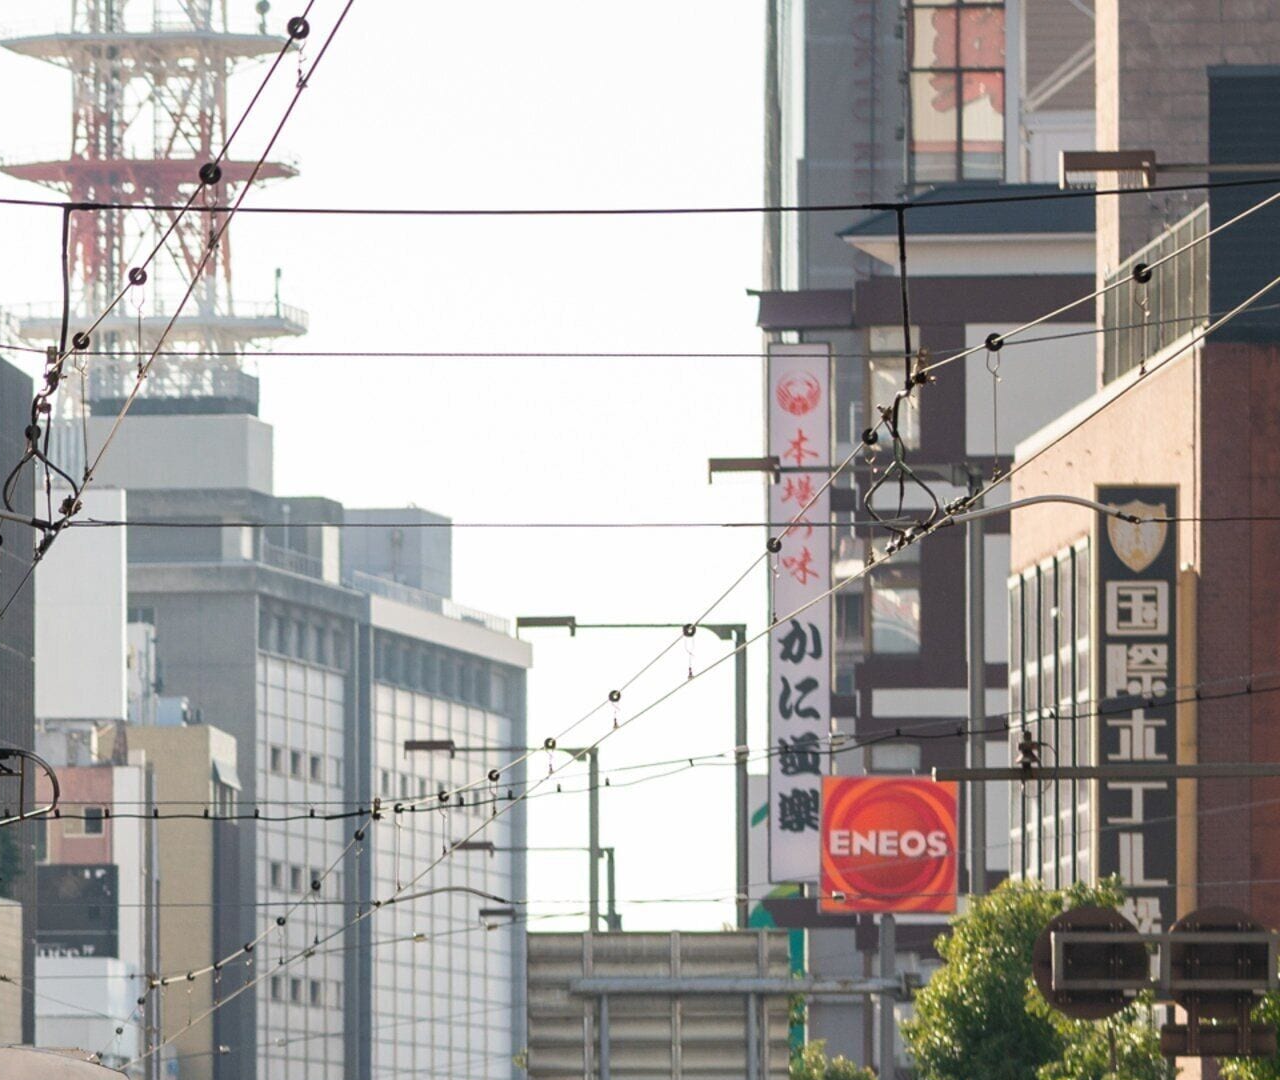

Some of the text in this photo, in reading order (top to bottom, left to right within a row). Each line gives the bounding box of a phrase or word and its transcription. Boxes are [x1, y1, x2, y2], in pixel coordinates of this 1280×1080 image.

[781, 427, 821, 586] 本場の味
[777, 619, 823, 834] かに道楽
[829, 829, 948, 859] ENEOS
